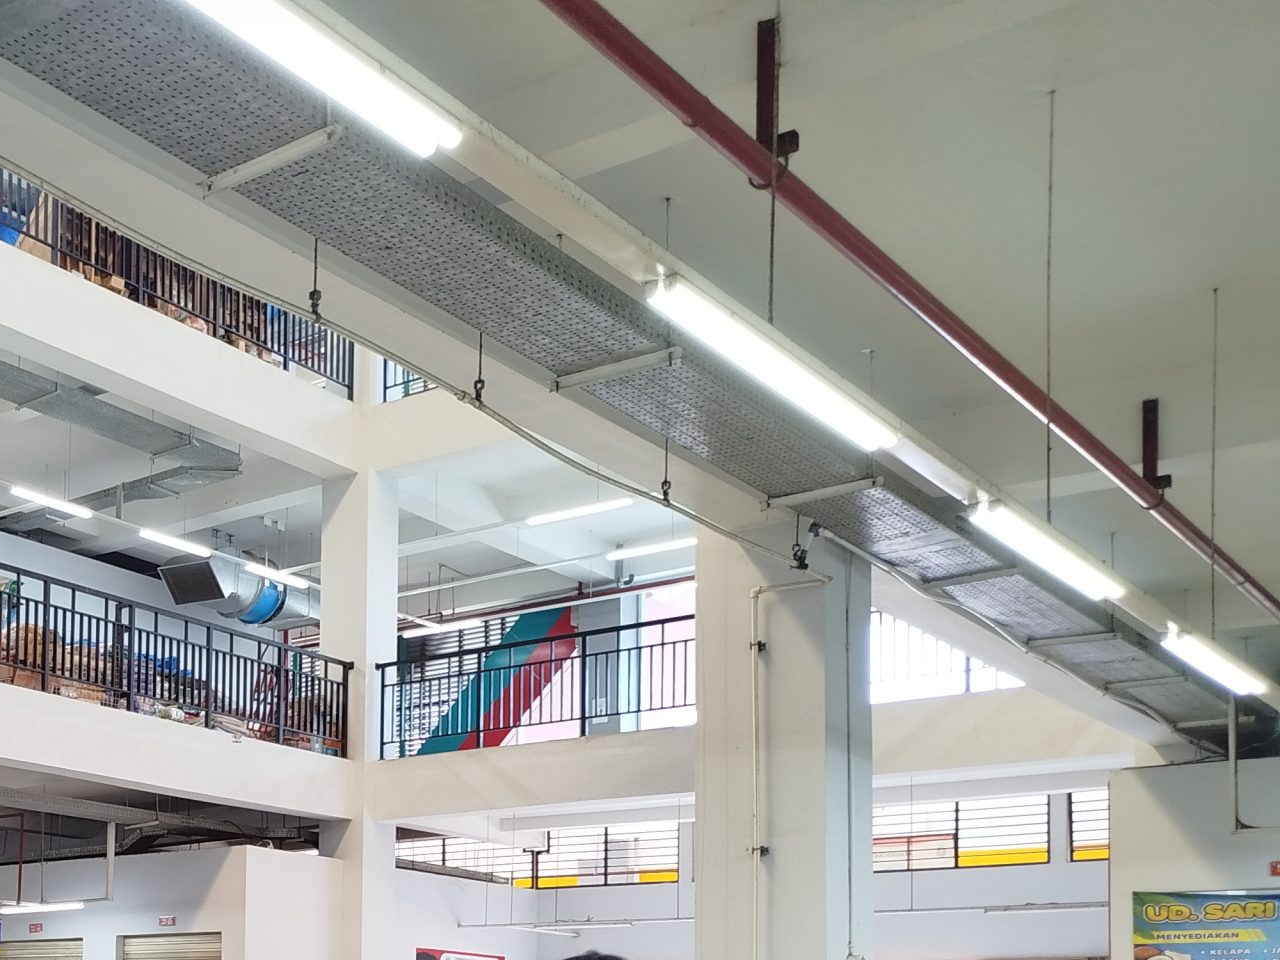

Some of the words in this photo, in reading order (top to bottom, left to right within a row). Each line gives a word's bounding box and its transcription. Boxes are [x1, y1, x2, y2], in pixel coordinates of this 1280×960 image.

[1144, 903, 1200, 922] UD.
[1203, 901, 1276, 921] SARI
[1156, 932, 1240, 940] MENYEDIAKAN
